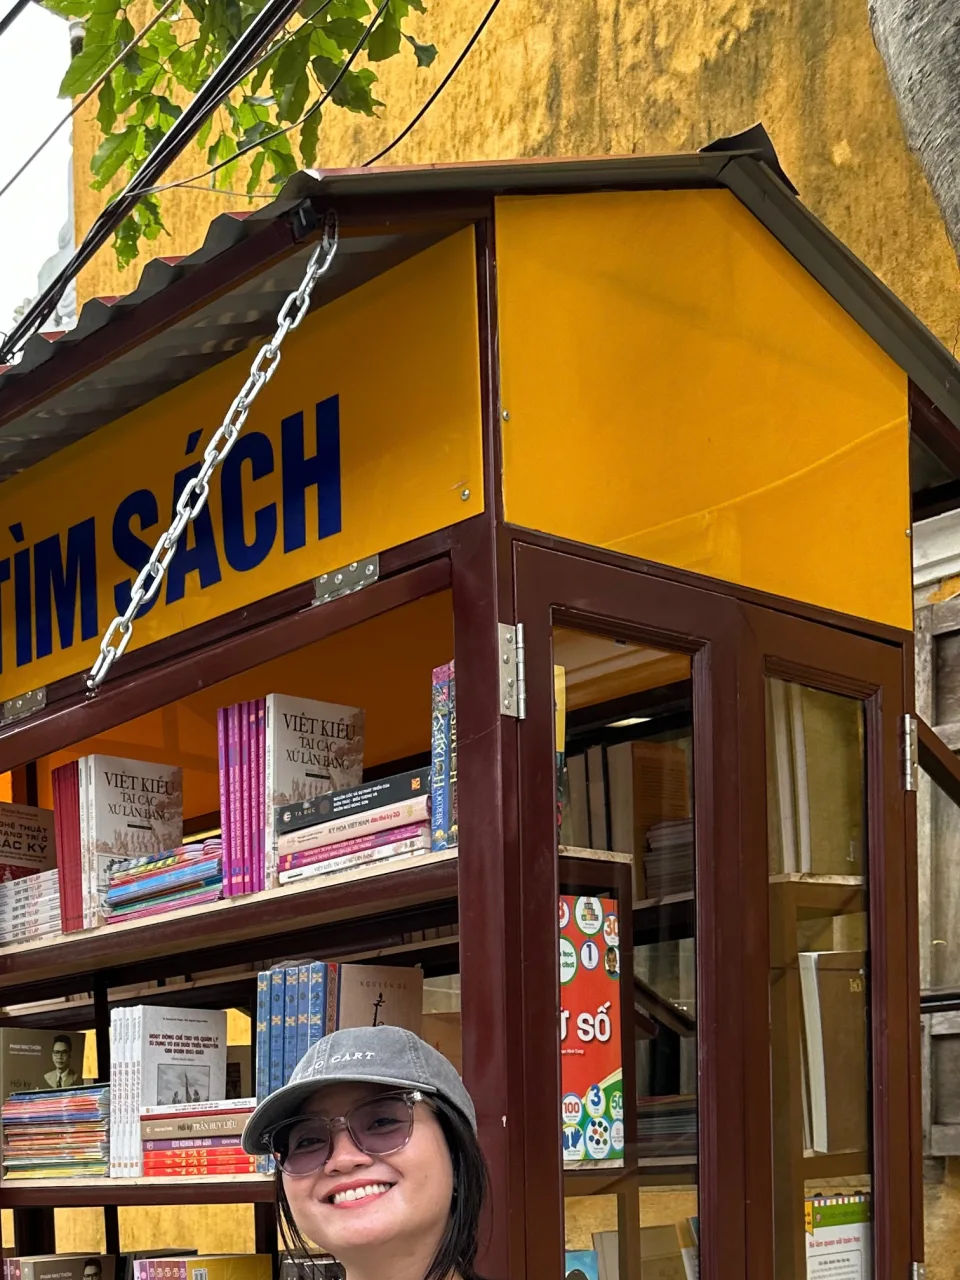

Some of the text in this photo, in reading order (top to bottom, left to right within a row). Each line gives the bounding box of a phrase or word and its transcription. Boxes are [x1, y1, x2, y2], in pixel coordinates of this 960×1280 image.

[112, 393, 342, 621] SÁCH
[283, 712, 319, 735] VIỆT
[104, 771, 138, 790] VIỆT
[586, 944, 592, 961] 1
[331, 1051, 375, 1063] CART
[590, 1084, 601, 1107] 3
[563, 1102, 580, 1114] 100
[192, 1122, 209, 1131] TRẦN
[209, 1121, 222, 1130] HUY
[223, 1120, 237, 1129] LIỆU
